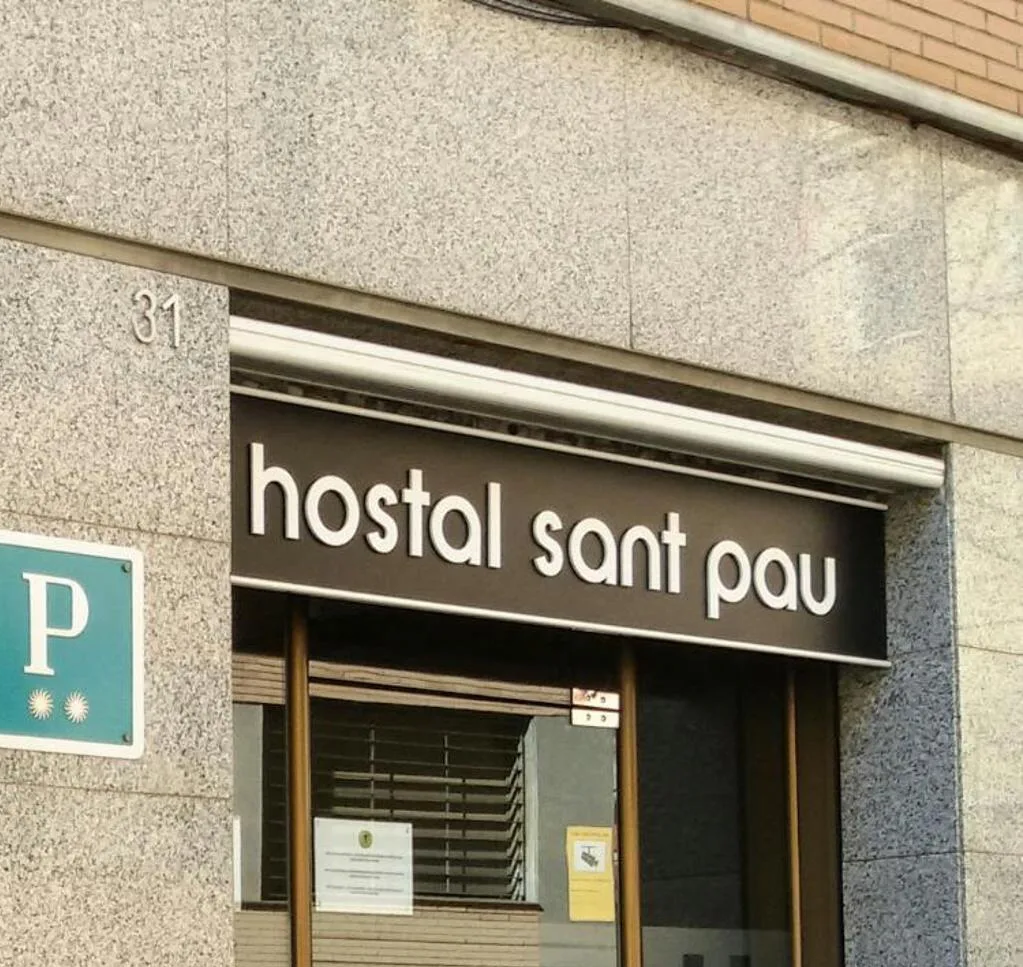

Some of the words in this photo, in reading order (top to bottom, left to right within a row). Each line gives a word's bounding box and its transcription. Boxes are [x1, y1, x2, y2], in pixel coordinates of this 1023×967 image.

[131, 288, 180, 347] 31
[250, 442, 502, 568] hostal
[532, 511, 686, 594] sant
[705, 540, 836, 619] pau
[22, 571, 89, 676] P
